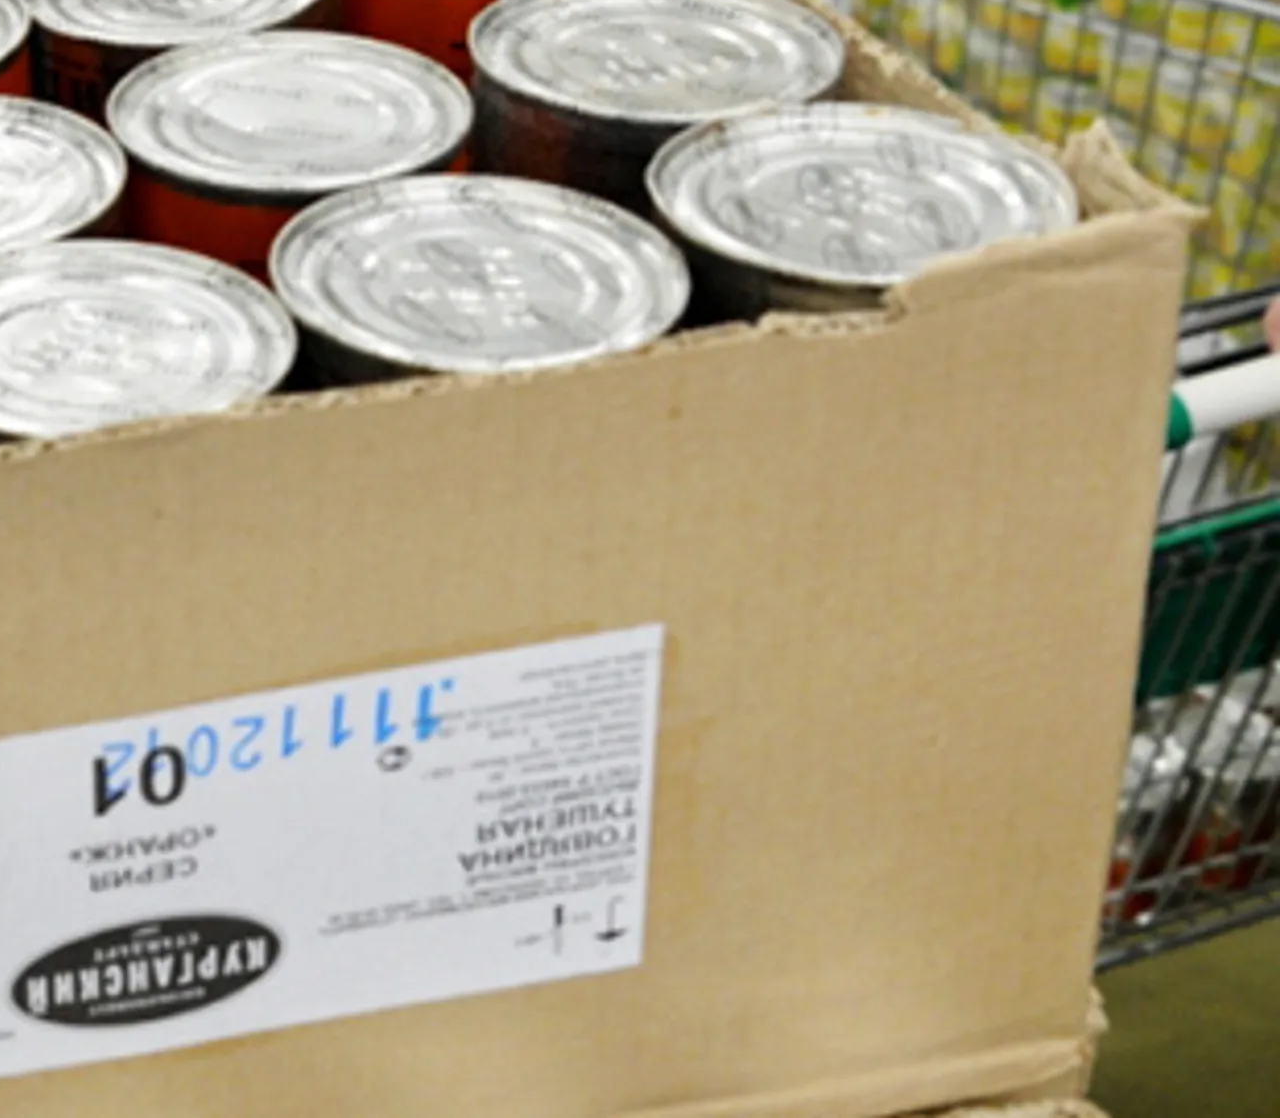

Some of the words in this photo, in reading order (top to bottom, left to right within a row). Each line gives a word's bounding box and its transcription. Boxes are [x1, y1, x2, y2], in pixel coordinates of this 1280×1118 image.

[91, 744, 186, 818] 01
[69, 825, 216, 864] «ОРАНЖ»
[476, 797, 636, 845] ТУШЕНАЯ
[457, 824, 637, 873] ГОВЯДИНА
[89, 856, 198, 893] СЕРИЯ
[93, 934, 200, 963] СТАНДАРТ
[25, 937, 269, 1020] КУРГАНСКИЙ
